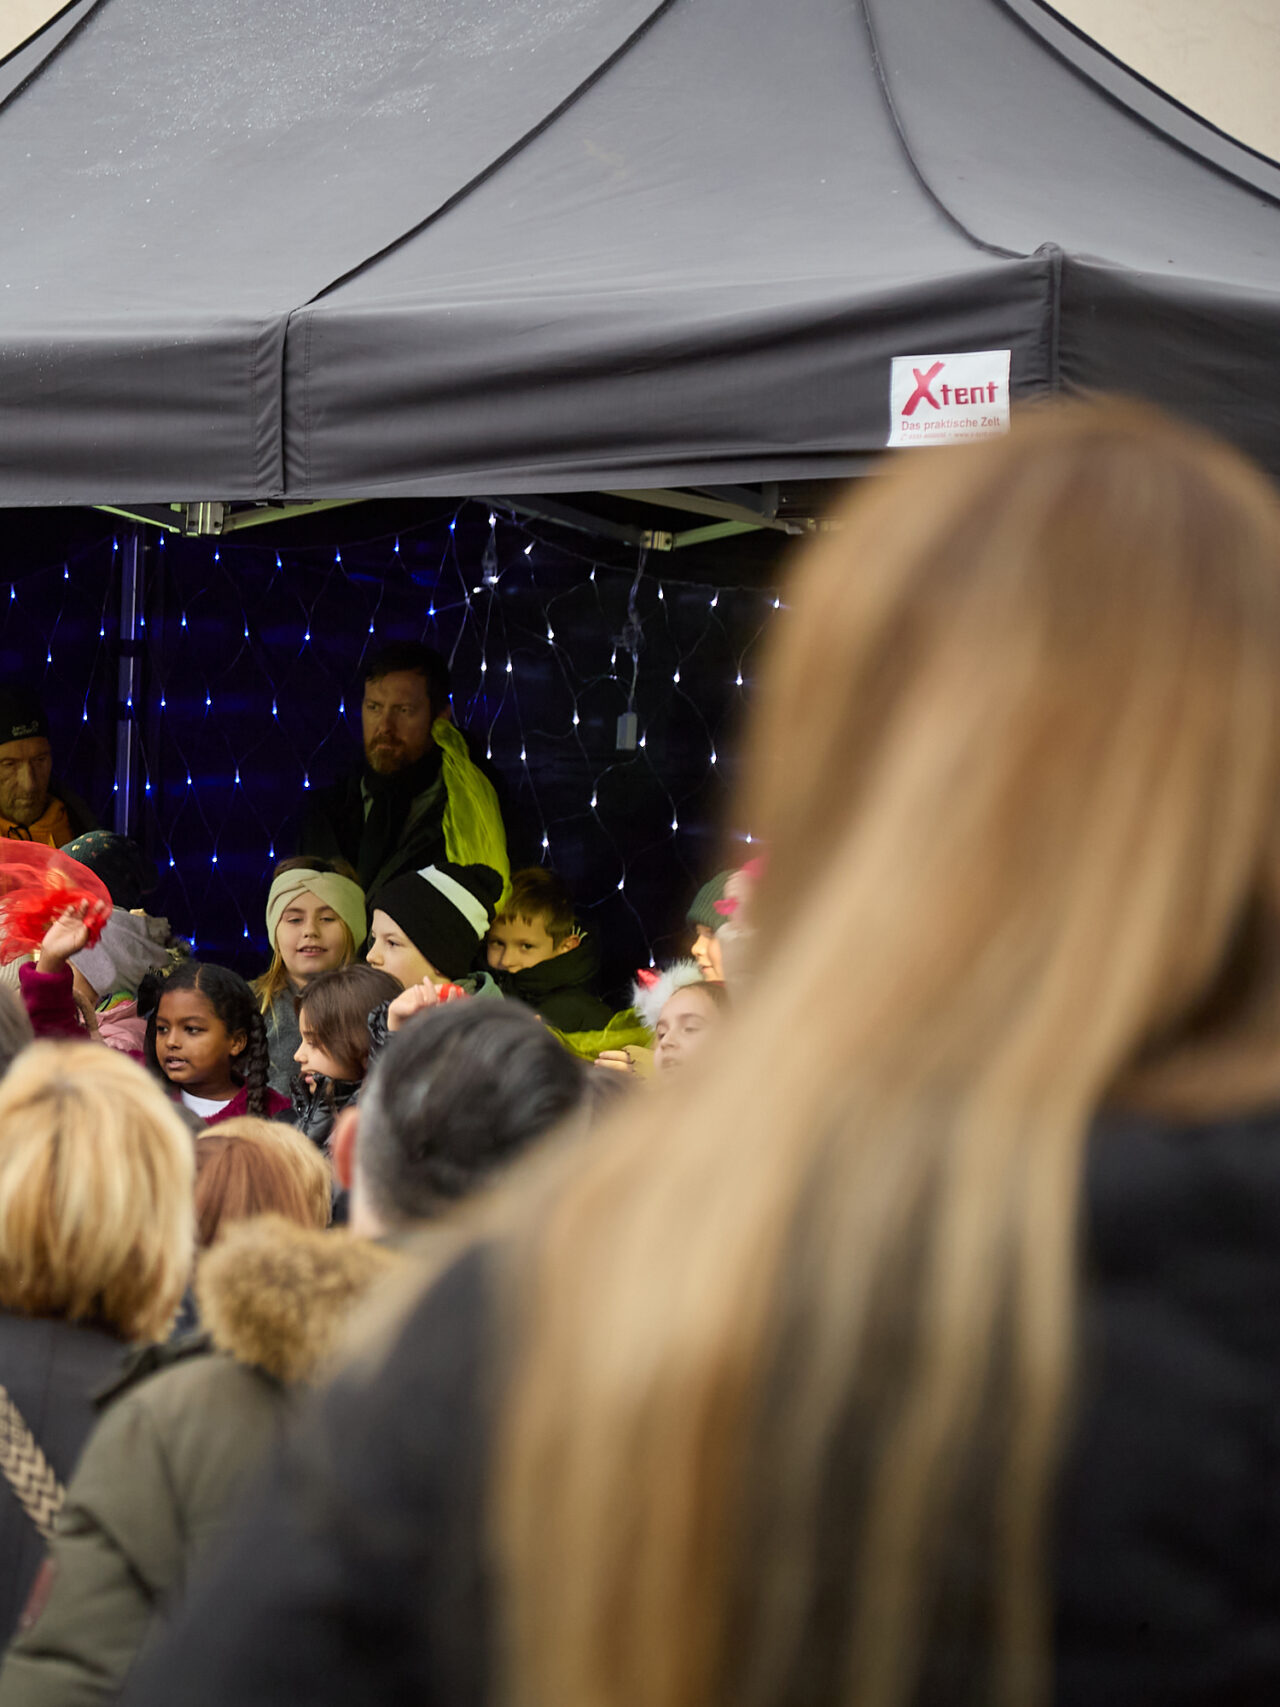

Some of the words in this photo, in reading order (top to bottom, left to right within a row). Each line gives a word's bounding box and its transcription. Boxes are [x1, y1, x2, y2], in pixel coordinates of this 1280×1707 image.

[901, 361, 999, 416] Xtent
[901, 420, 920, 431] Das
[924, 418, 978, 432] praktische
[981, 416, 1000, 428] Zelt
